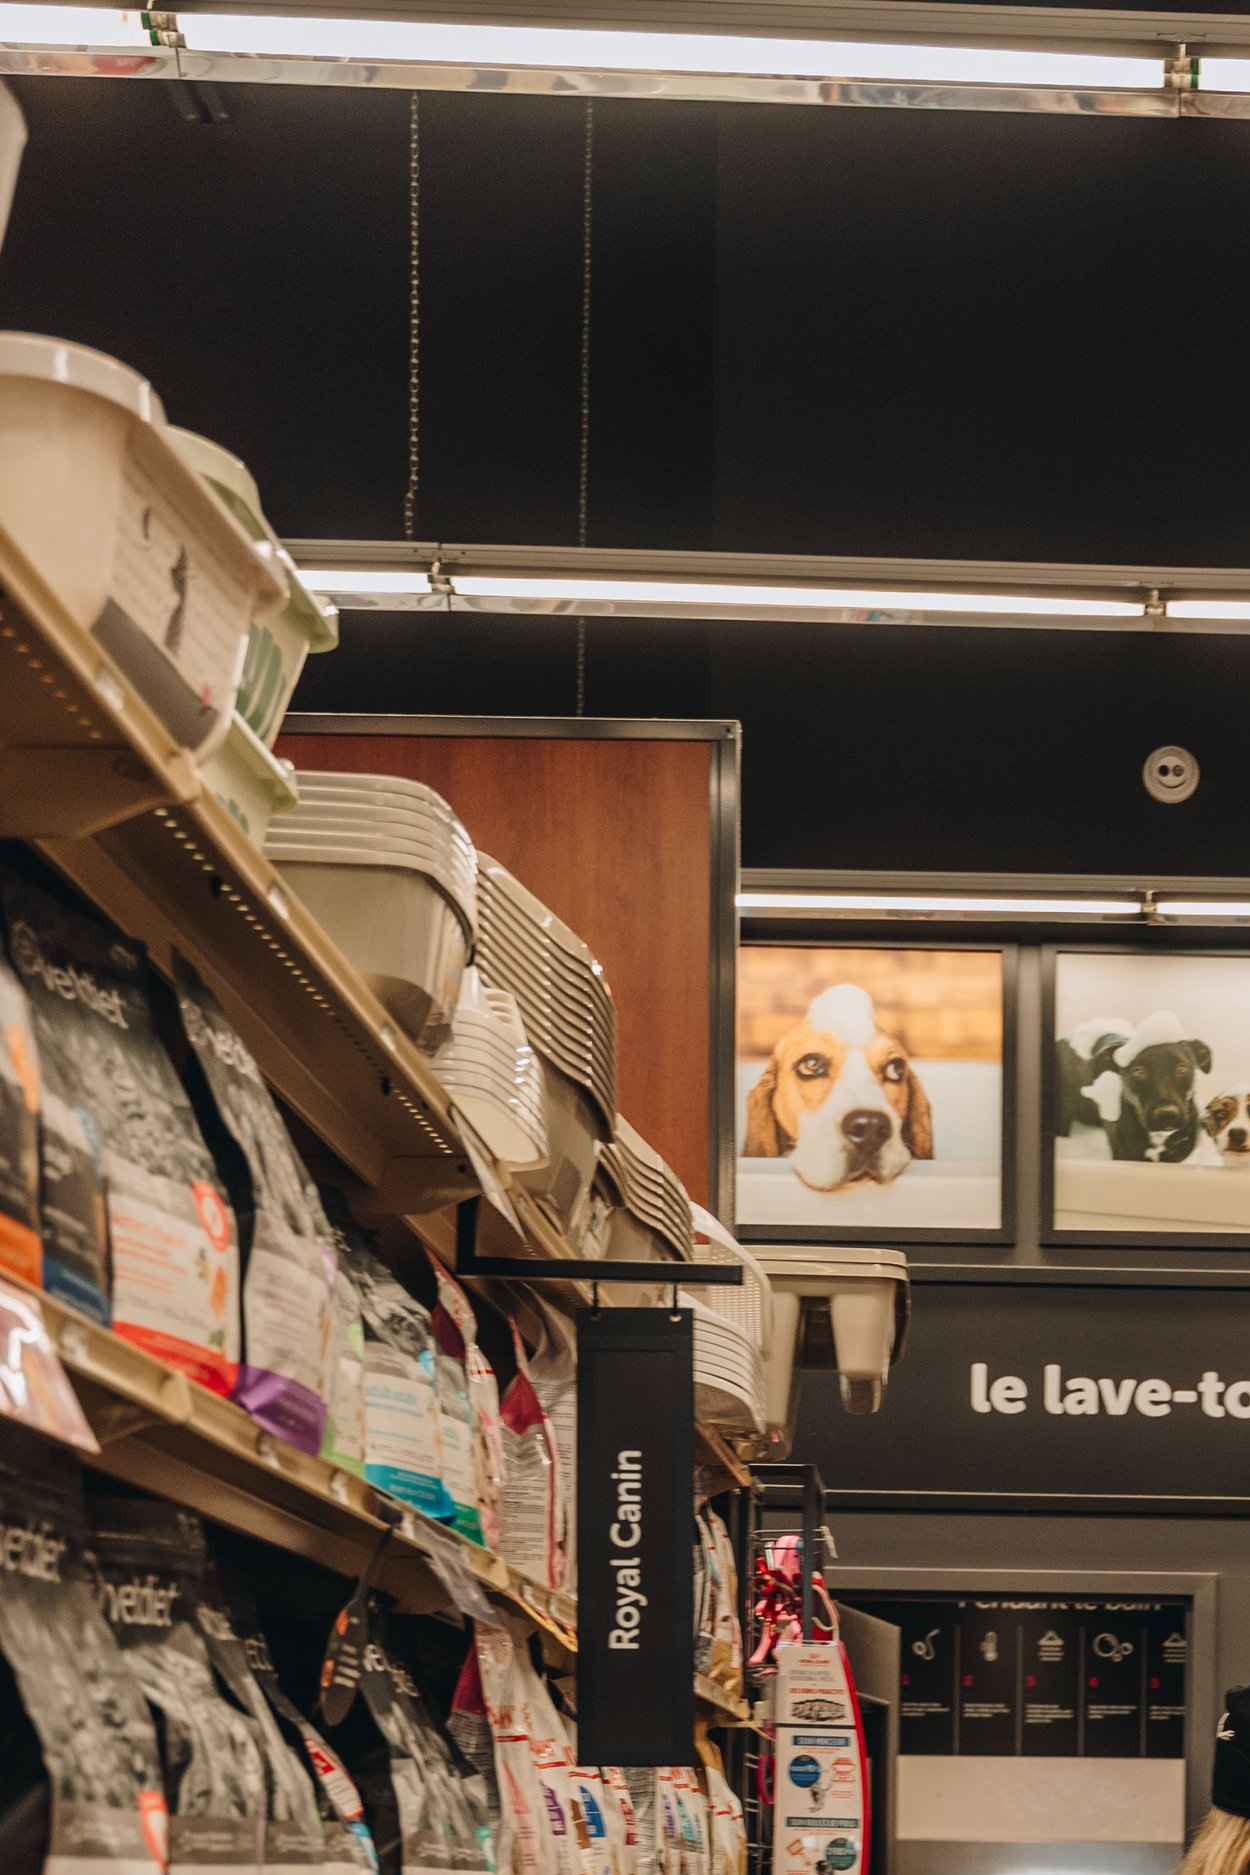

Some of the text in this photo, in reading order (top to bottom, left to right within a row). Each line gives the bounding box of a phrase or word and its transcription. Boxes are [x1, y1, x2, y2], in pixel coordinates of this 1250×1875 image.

[970, 1362, 1028, 1414] le
[609, 1449, 648, 1650] Royal Canin
